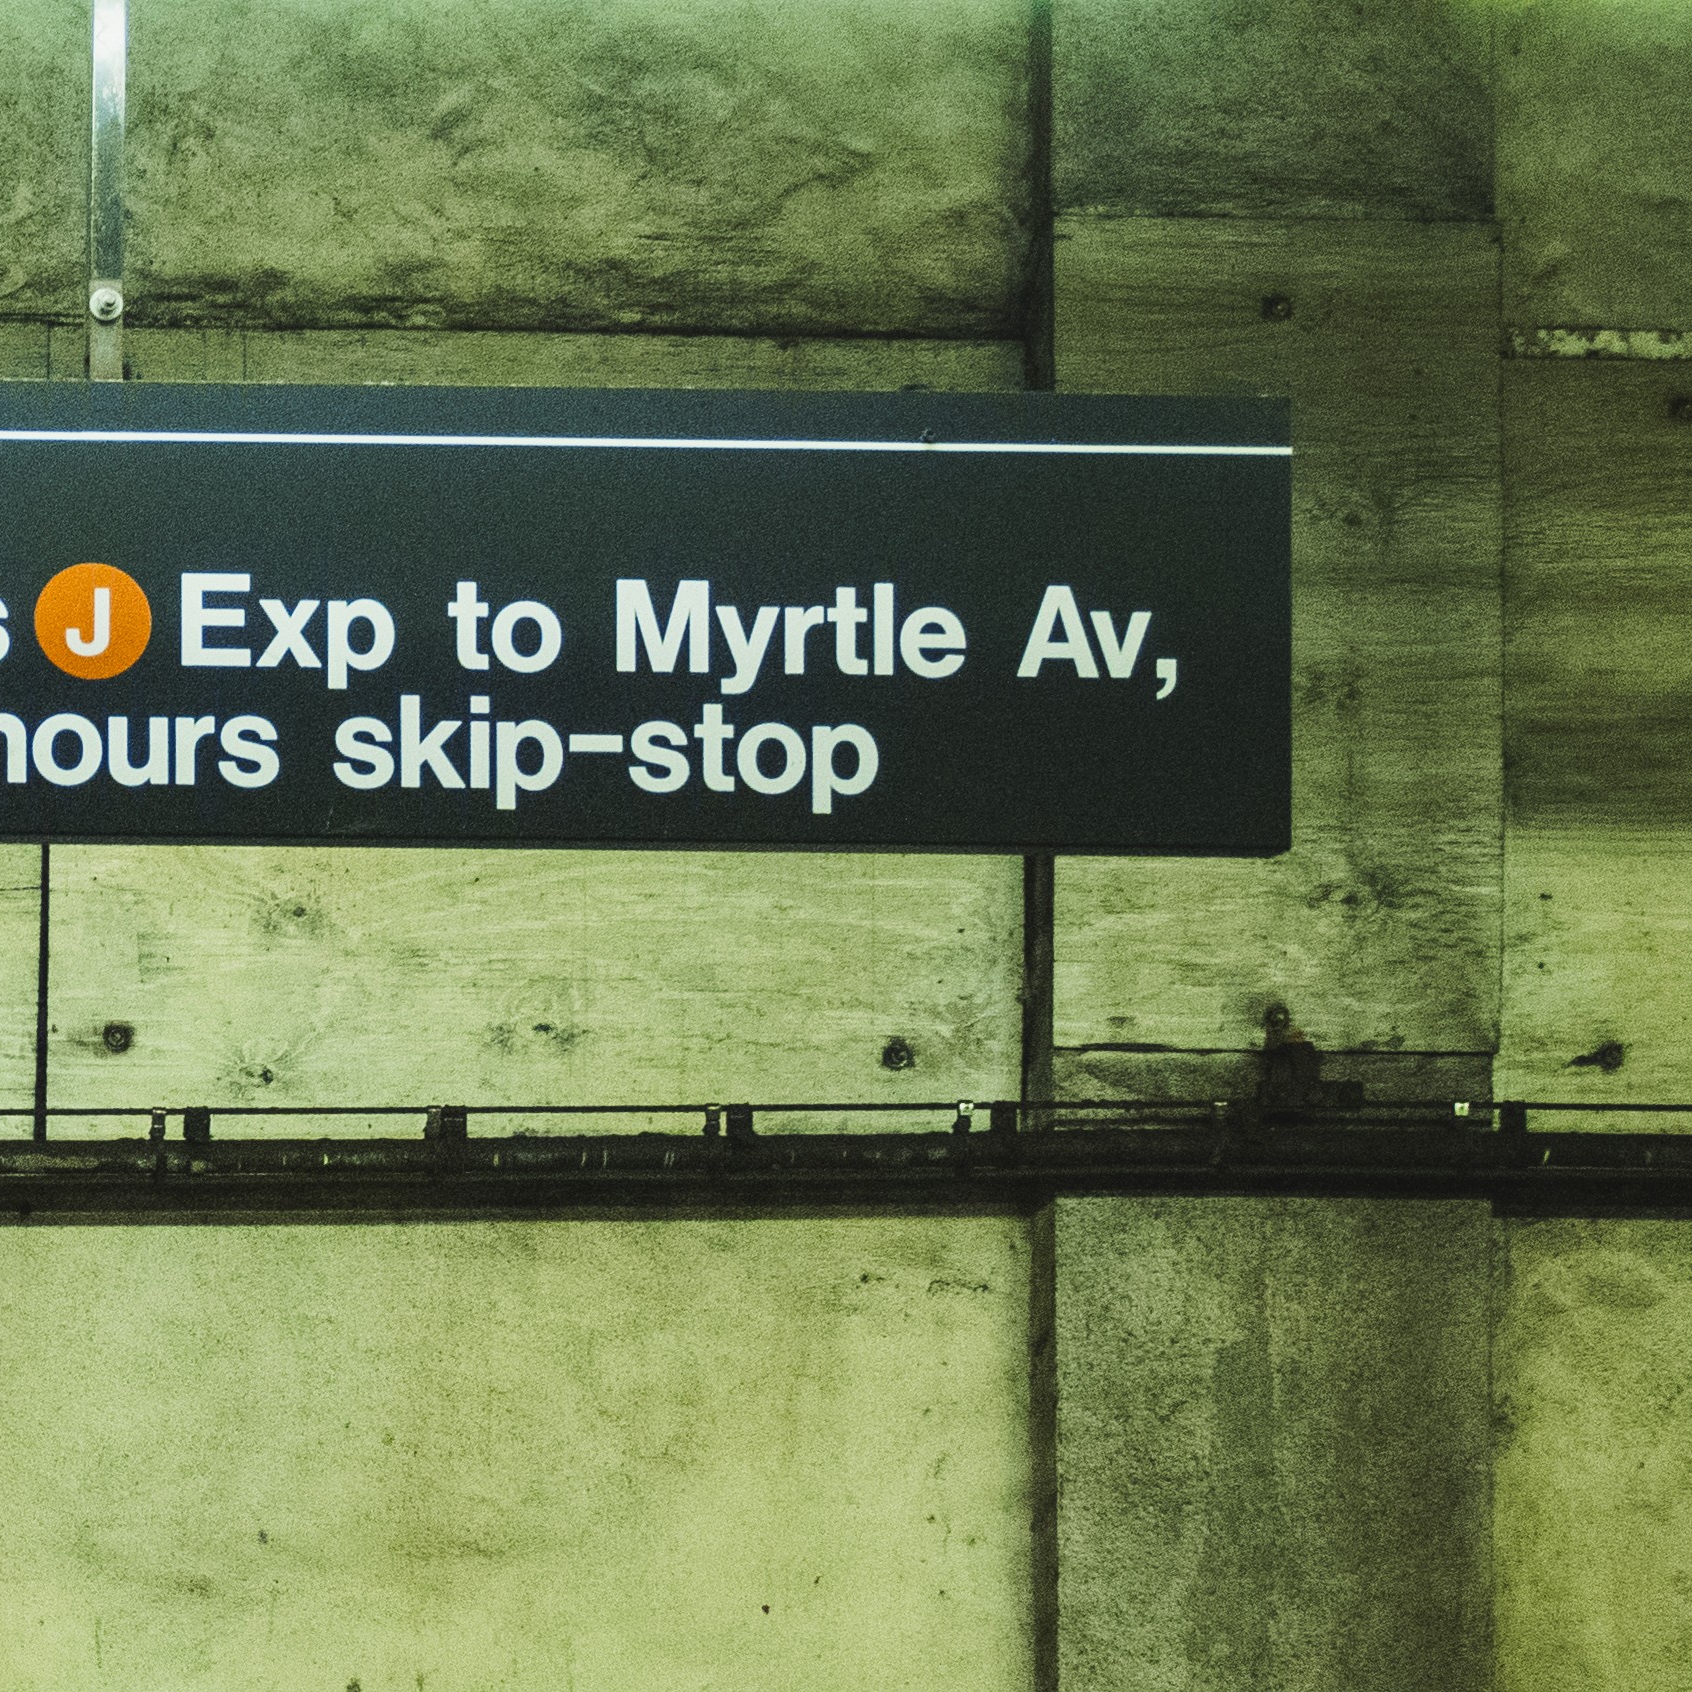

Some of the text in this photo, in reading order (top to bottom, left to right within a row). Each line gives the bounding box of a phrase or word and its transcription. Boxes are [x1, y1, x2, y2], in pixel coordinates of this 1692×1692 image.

[65, 587, 111, 657] J
[180, 572, 396, 690] Exp
[447, 580, 562, 674] to
[615, 578, 967, 695] Myrtle
[1016, 585, 1178, 700] Av,
[332, 694, 879, 815] skip-stop
